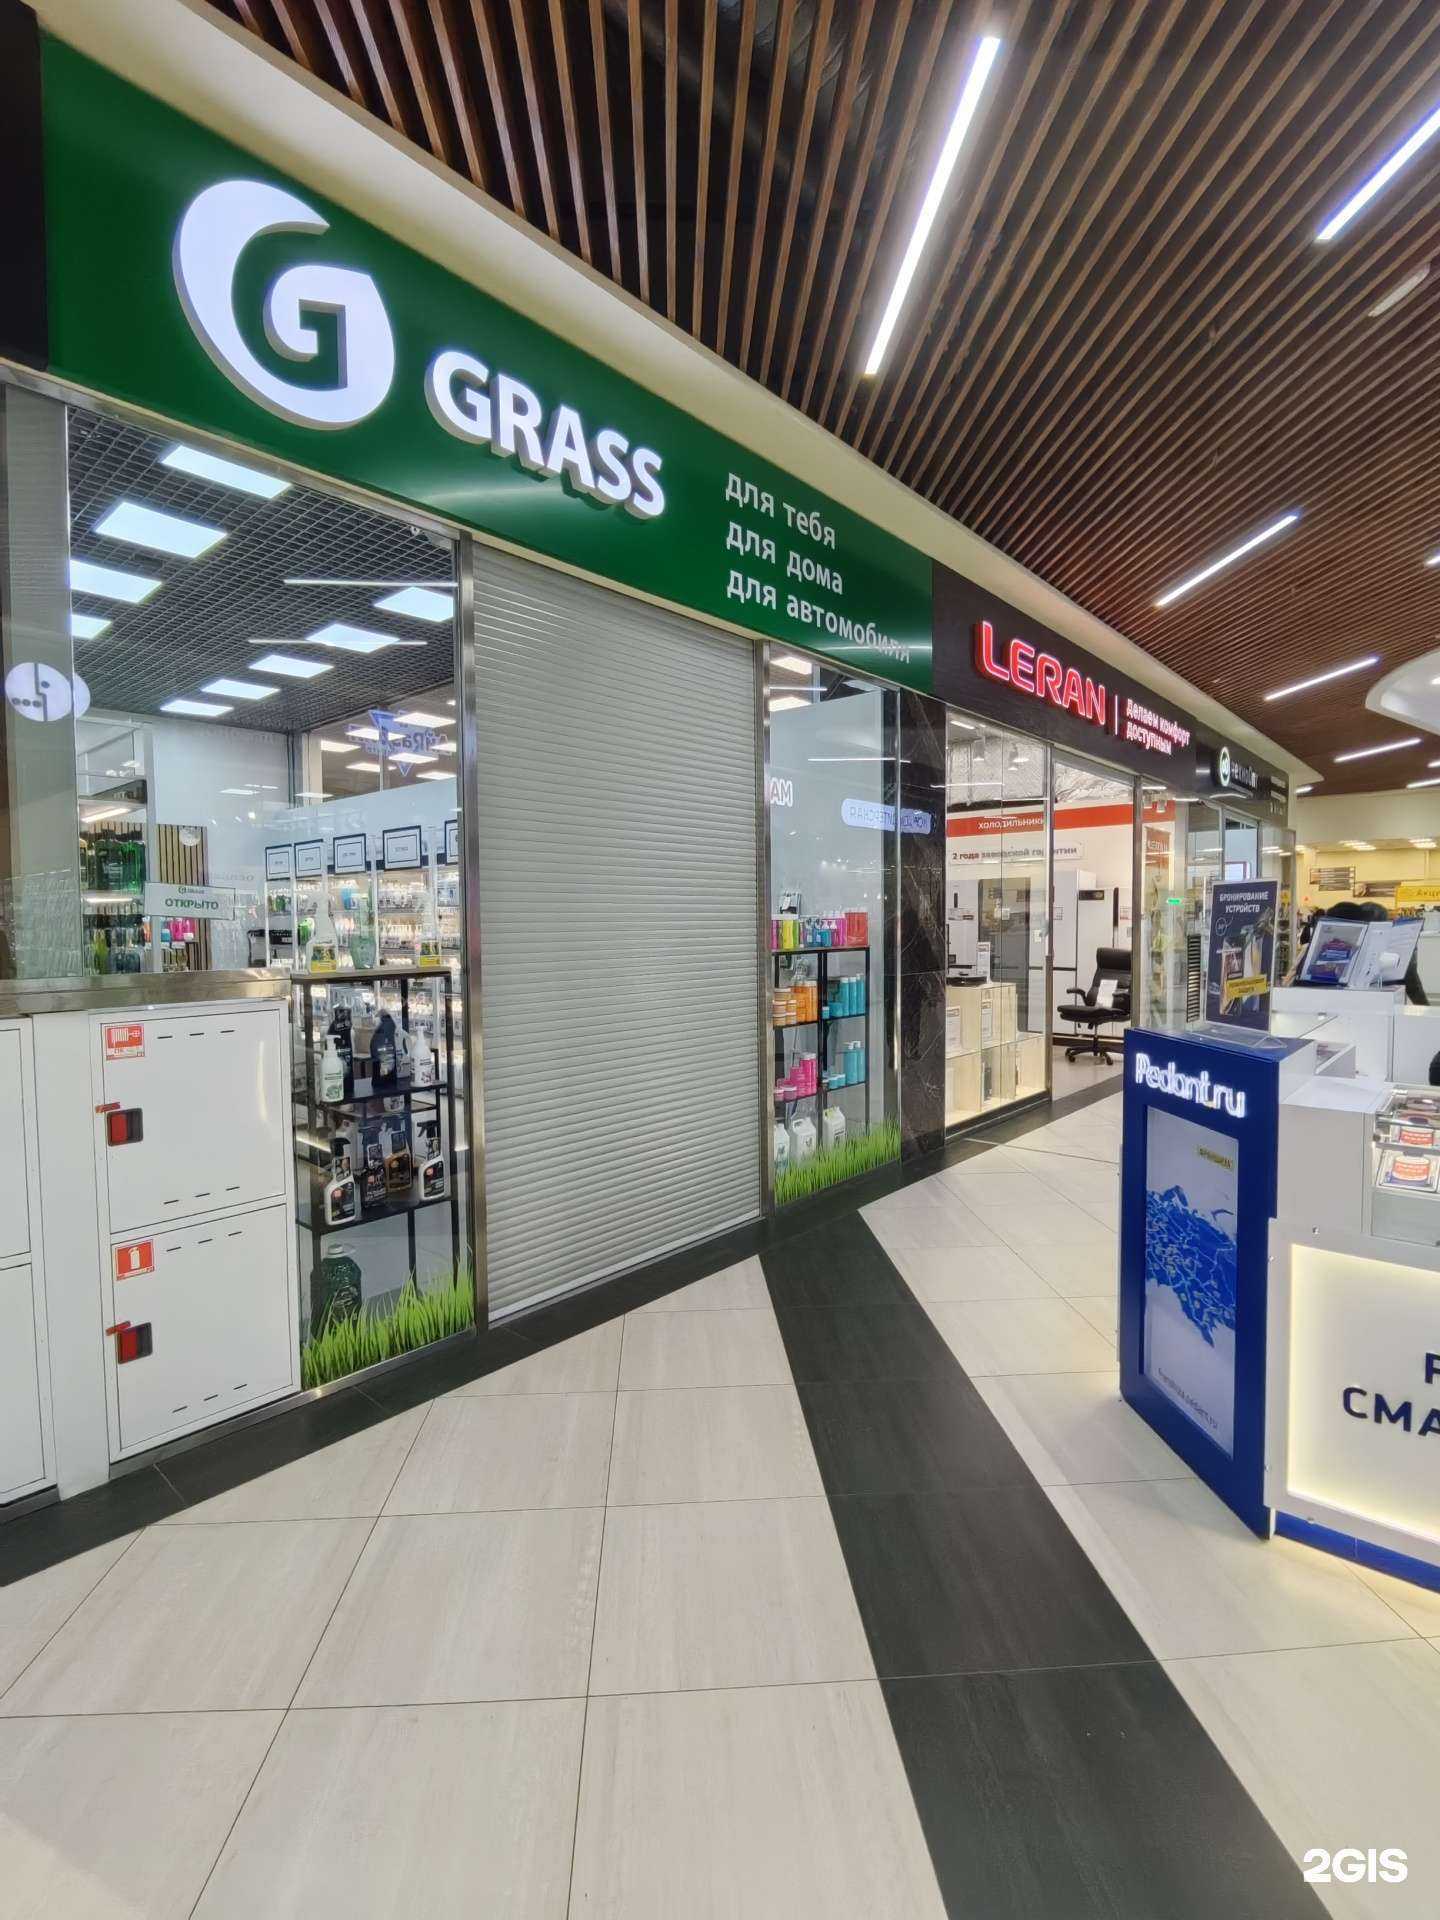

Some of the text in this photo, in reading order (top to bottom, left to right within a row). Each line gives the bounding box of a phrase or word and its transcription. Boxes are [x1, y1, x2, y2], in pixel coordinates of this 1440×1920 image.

[424, 350, 666, 519] GRASS
[725, 472, 836, 550] для тебя
[726, 521, 844, 595] для дома
[726, 569, 910, 664] для автомобиля
[975, 620, 1106, 726] LERAN
[164, 898, 219, 910] ОТКРЫТО
[1219, 891, 1269, 902] БРОНИРОВАНИЕ
[1225, 902, 1260, 913] УСТРОЙСТВ
